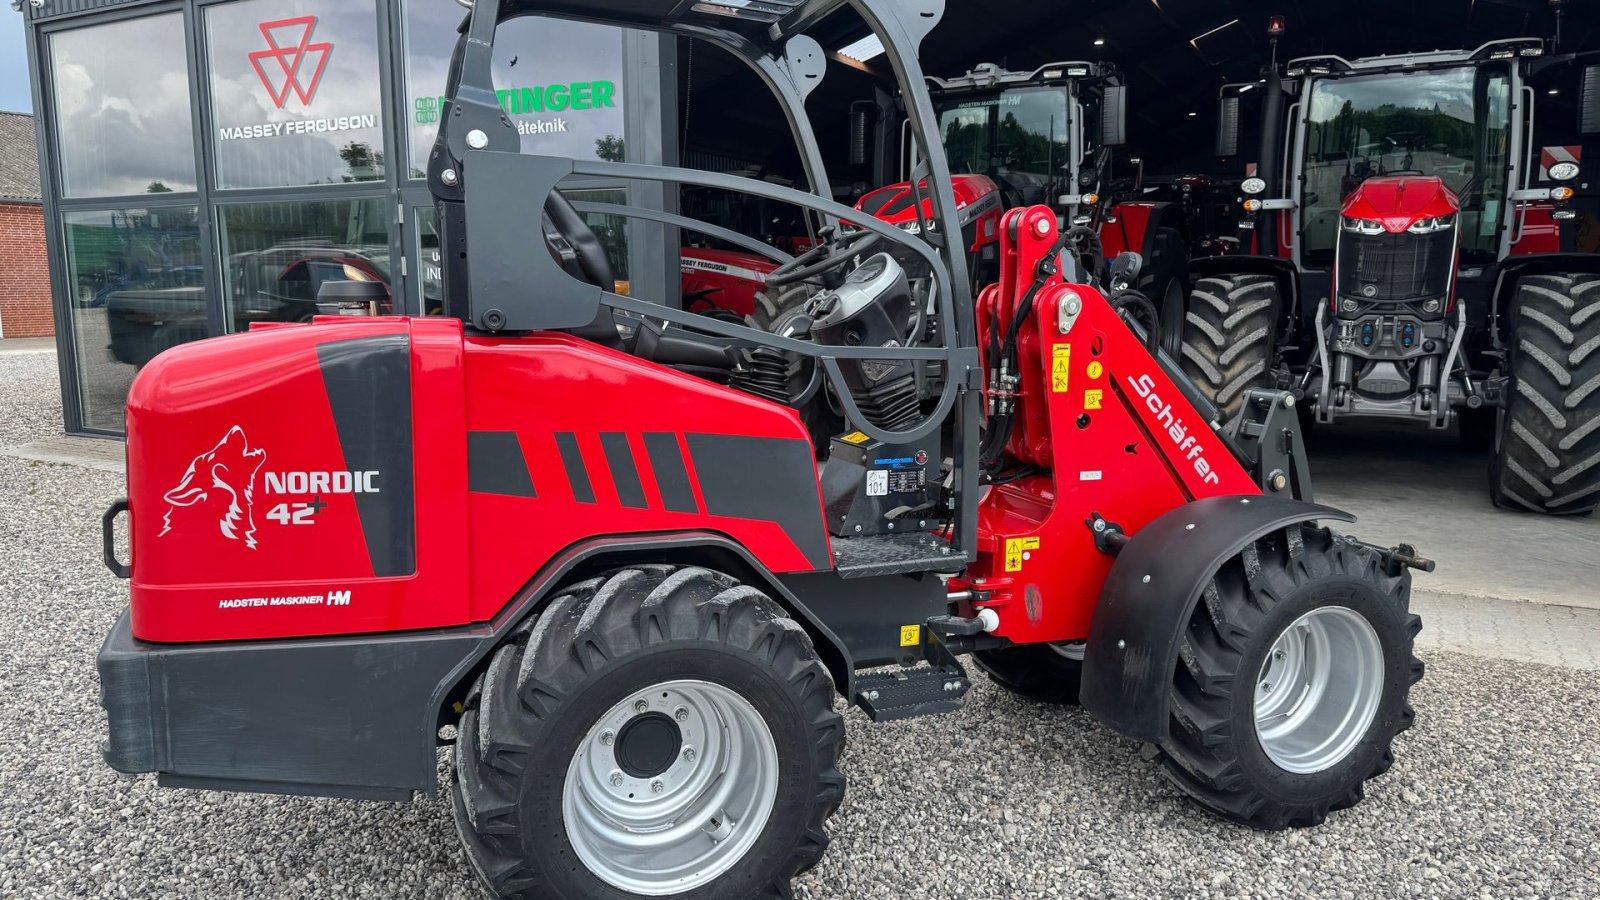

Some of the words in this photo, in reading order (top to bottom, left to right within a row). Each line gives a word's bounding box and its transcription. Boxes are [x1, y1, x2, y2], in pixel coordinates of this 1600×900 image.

[220, 123, 282, 141] MASSEY
[286, 114, 374, 135] FERGUSON
[516, 118, 566, 136] åteknik
[697, 261, 727, 271] FERGUSON
[1127, 374, 1219, 485] Schäffer
[265, 471, 379, 494] NORDIC
[869, 481, 882, 494] 101
[219, 597, 268, 608] HADSTEN
[270, 595, 324, 606] MASKINER
[326, 590, 351, 606] HM
